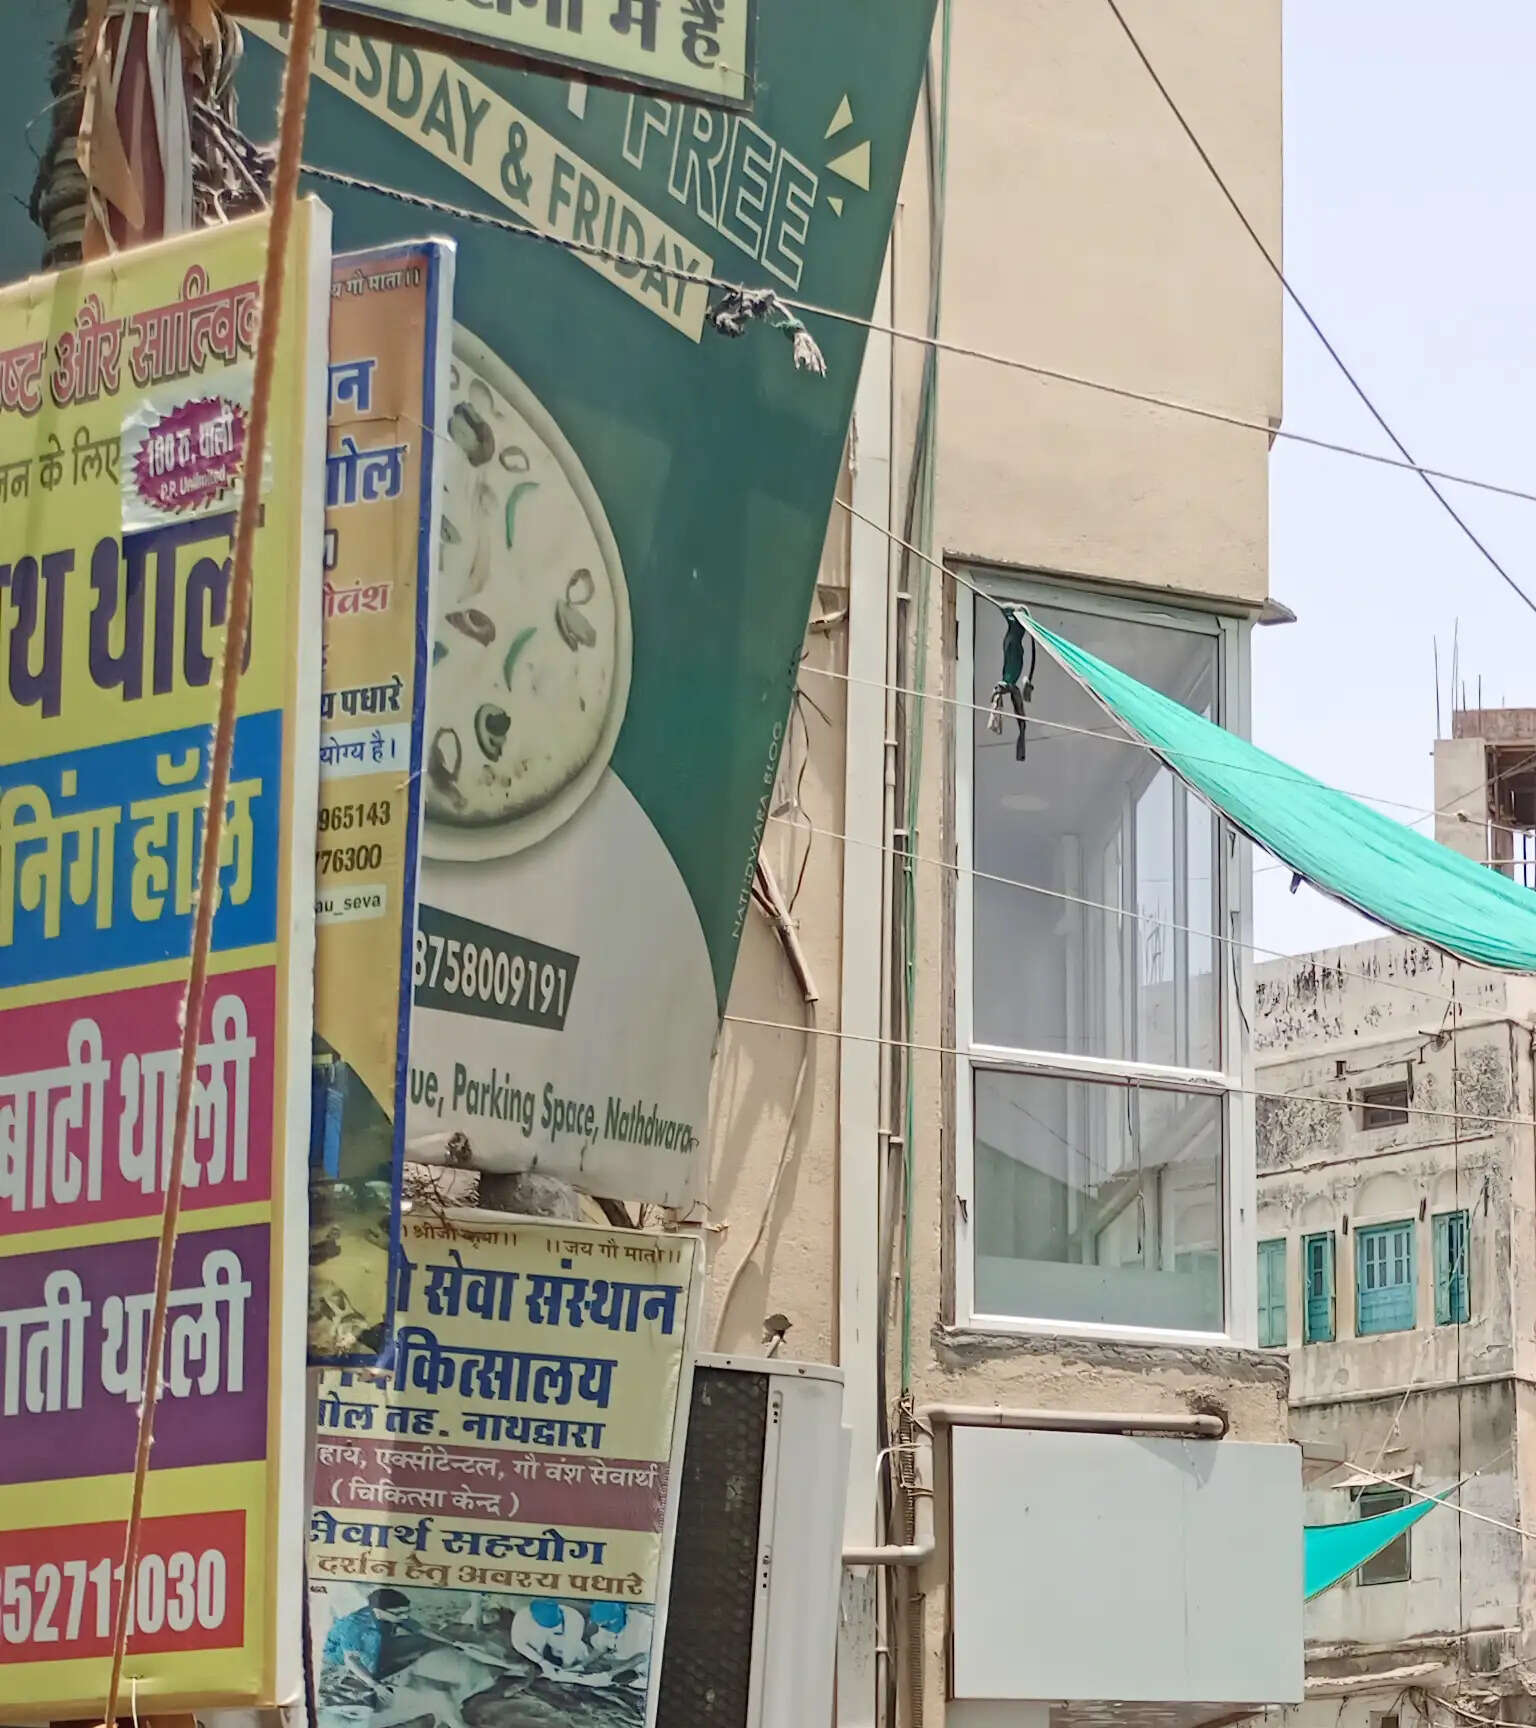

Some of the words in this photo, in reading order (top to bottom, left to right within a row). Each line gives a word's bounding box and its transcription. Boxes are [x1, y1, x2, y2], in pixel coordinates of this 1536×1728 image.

[548, 153, 701, 316] FRIDAY
[622, 92, 818, 291] FREE
[52, 294, 125, 410] और
[39, 433, 66, 492] के
[72, 425, 121, 485] लिए
[453, 1061, 535, 1138] Parking
[541, 1081, 600, 1145] Space,
[424, 1248, 520, 1322] सेवा
[525, 1257, 684, 1336] संस्थान
[462, 1410, 606, 1451] नाथद्वारा
[513, 1454, 538, 1481] गौ
[545, 1457, 583, 1487] वंश
[0, 1547, 227, 1645] 52711030
